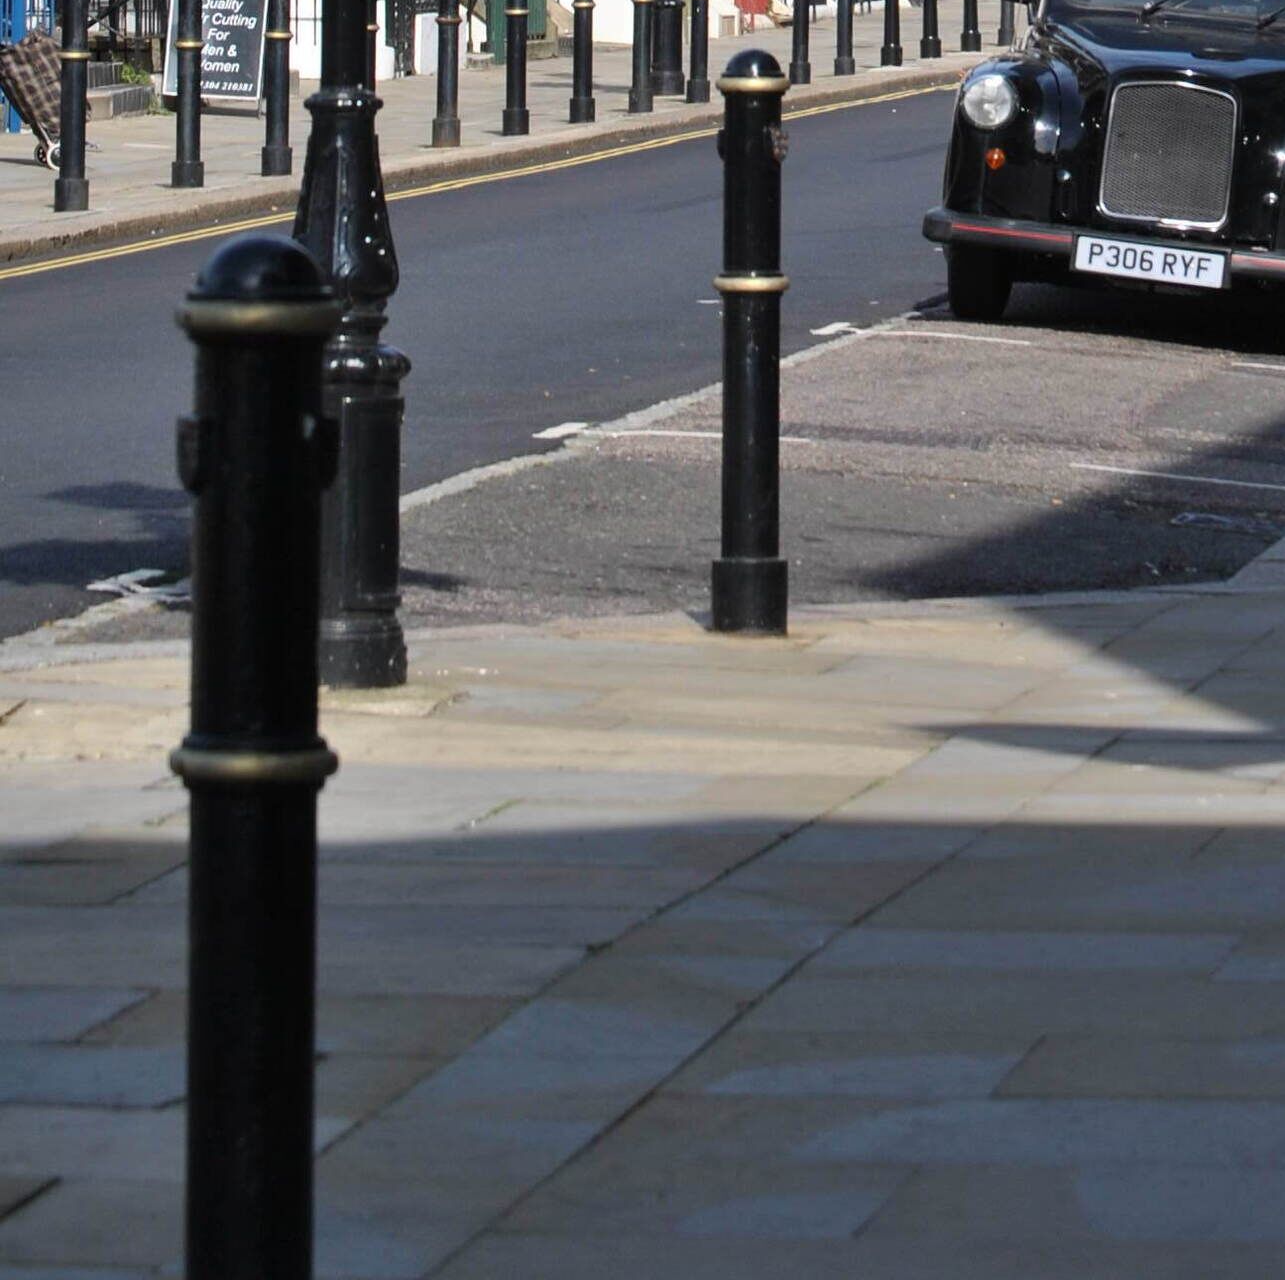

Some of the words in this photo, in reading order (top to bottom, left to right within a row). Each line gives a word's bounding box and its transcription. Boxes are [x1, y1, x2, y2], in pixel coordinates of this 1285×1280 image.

[212, 13, 257, 29] Cutting
[208, 28, 231, 41] For
[227, 44, 238, 57] &
[201, 60, 240, 73] omen
[1088, 243, 1154, 272] P306
[1162, 253, 1211, 279] RYF
